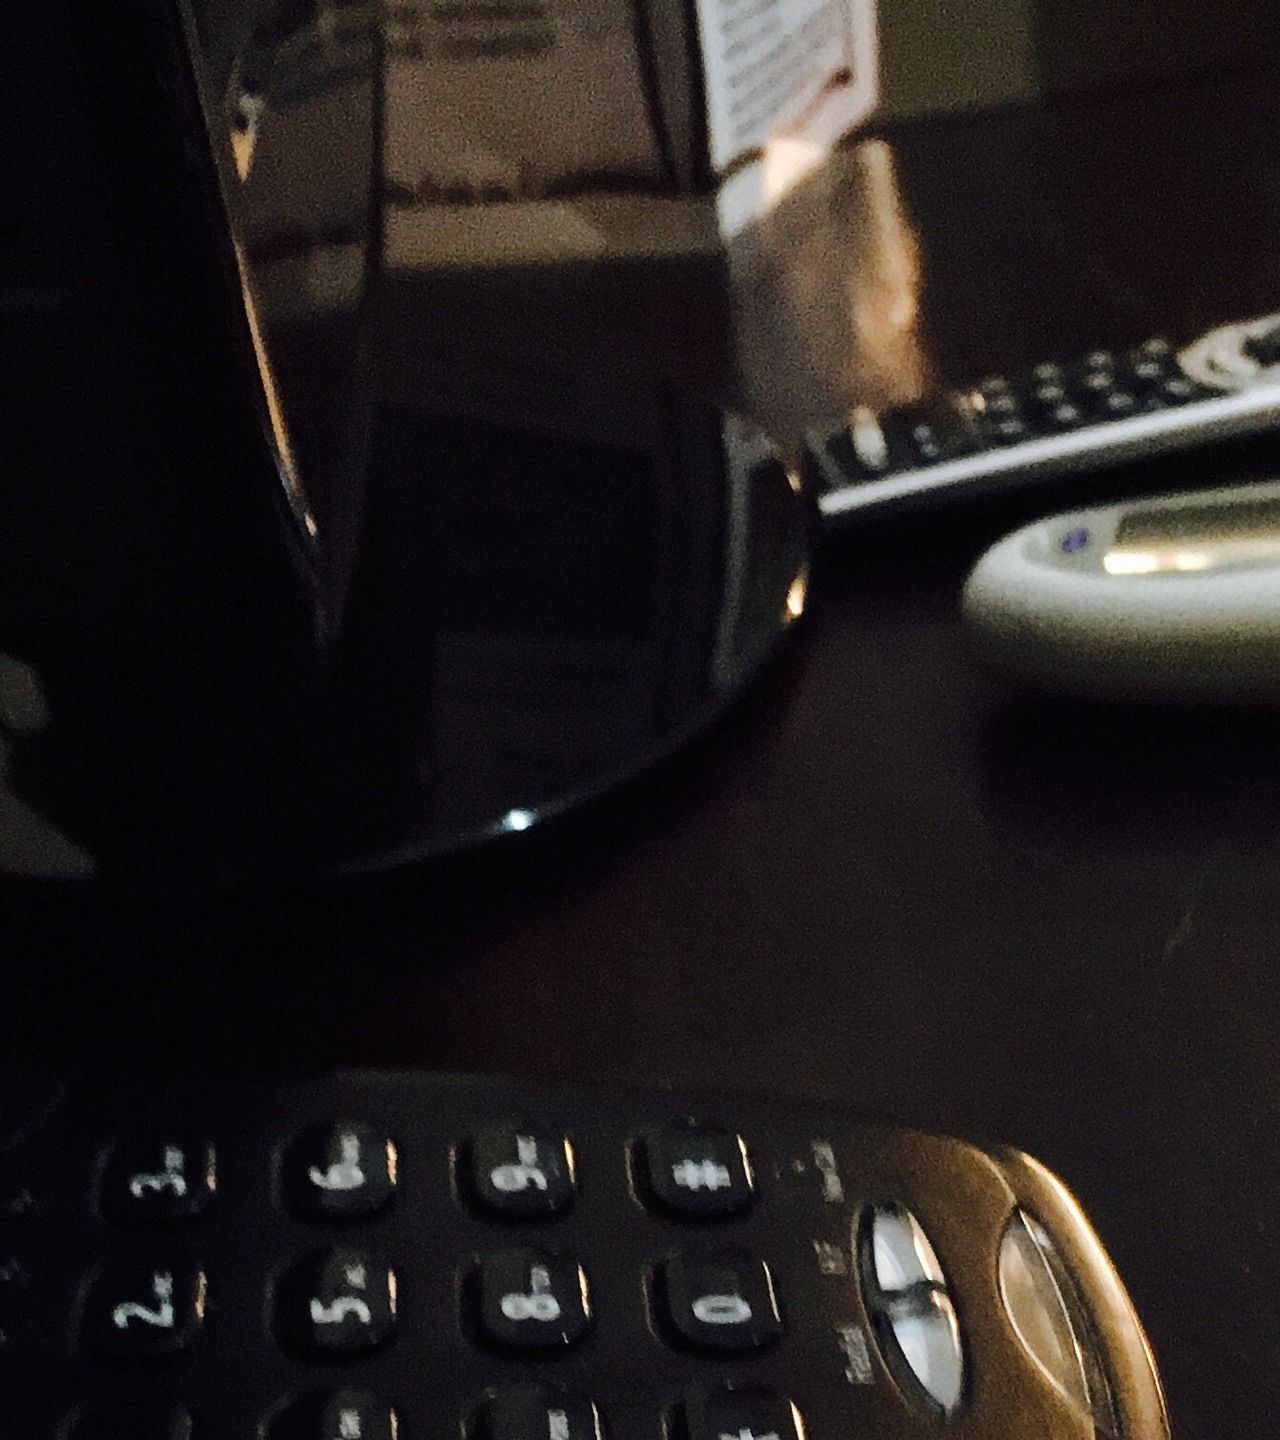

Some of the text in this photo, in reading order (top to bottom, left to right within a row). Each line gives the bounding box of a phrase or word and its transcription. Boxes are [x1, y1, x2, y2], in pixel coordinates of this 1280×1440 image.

[129, 1171, 187, 1198] 3
[308, 1164, 365, 1190] 6
[490, 1164, 548, 1192] 9
[112, 1300, 174, 1329] 2
[310, 1297, 371, 1324] 5
[500, 1293, 561, 1321] 8
[692, 1294, 753, 1325] 0
